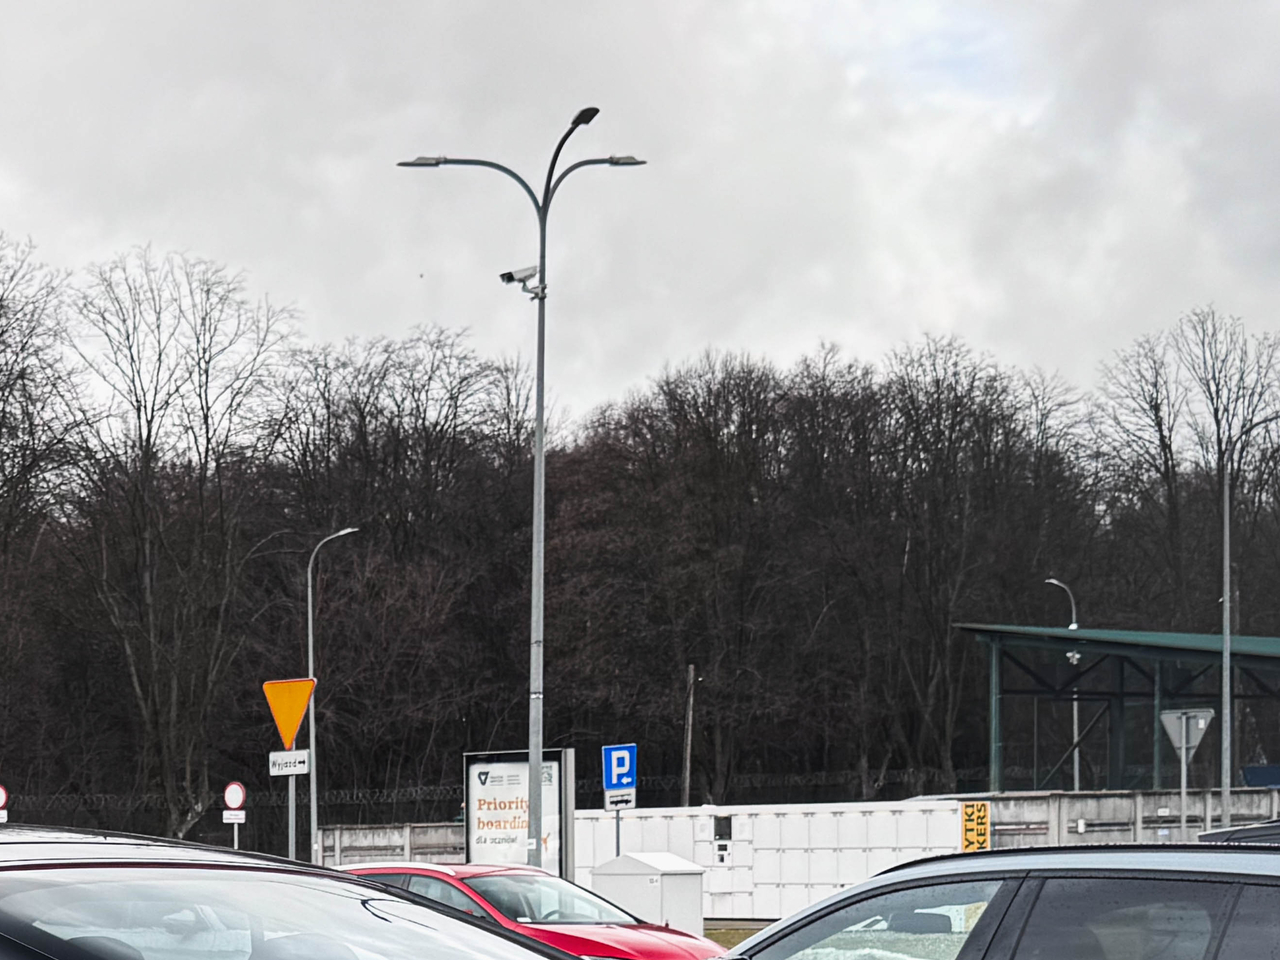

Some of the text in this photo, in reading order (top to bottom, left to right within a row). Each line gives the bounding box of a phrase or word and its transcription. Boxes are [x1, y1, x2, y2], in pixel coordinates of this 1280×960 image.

[611, 750, 630, 784] P
[477, 796, 529, 814] Priority
[477, 816, 529, 830] boardin
[965, 804, 975, 850] YTKI
[976, 803, 986, 850] KERS
